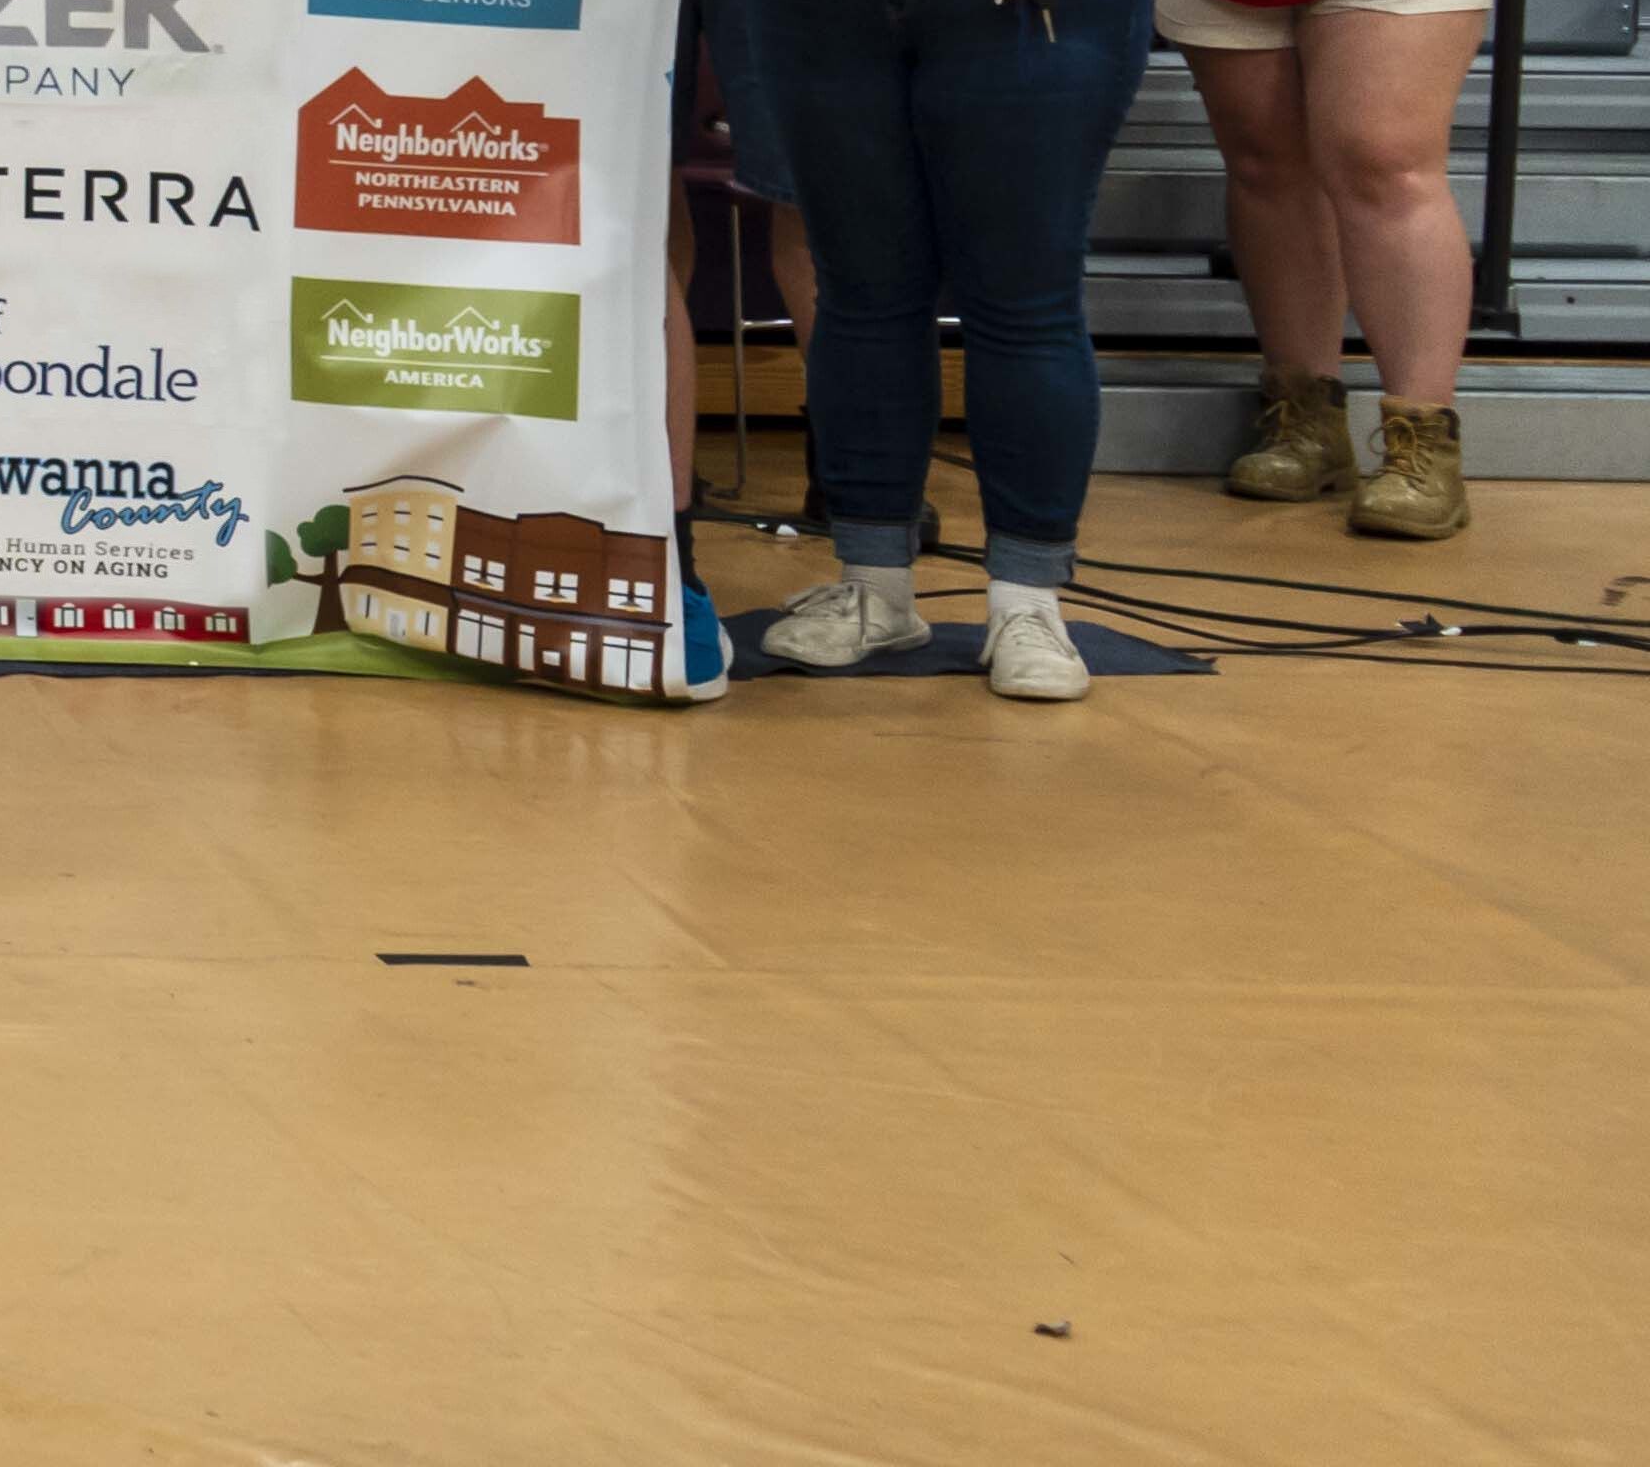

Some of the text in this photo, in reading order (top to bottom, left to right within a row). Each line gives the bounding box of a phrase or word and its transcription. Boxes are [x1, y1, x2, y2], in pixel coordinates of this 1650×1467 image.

[335, 121, 541, 162] NeighborWorks
[354, 171, 521, 196] NORTHEASTERN
[357, 193, 517, 218] PENNSYLVANIA
[327, 318, 542, 358] NeighborWorks
[383, 368, 485, 390] AMERICA
[60, 479, 251, 548] County
[6, 538, 88, 556] Human
[94, 541, 195, 562] Services
[53, 559, 87, 576] ON
[93, 561, 170, 579] AGING
